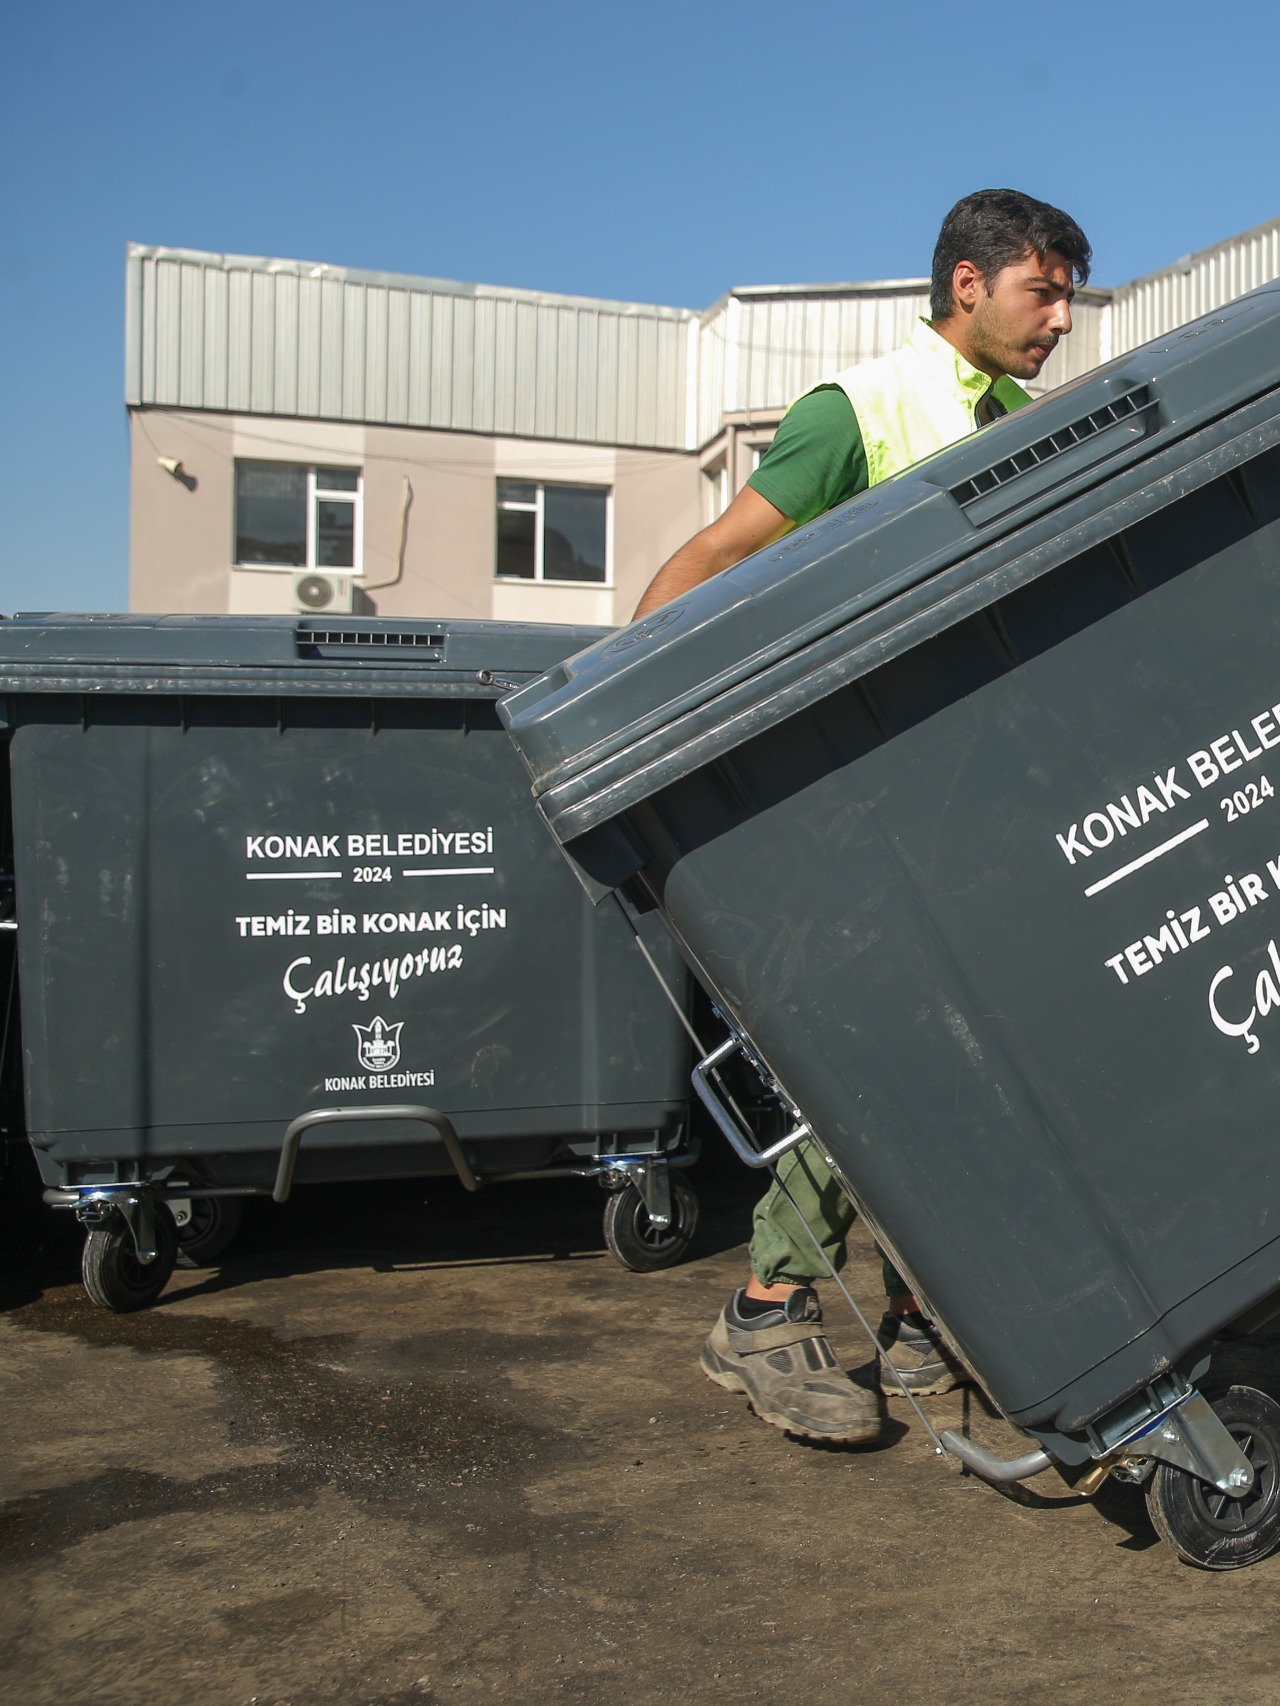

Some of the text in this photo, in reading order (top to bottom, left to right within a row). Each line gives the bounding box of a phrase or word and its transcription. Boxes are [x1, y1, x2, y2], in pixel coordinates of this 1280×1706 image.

[1056, 767, 1191, 864] KONAK
[1220, 776, 1275, 823] 2024
[247, 827, 493, 858] KONAK BELEDİYESİ
[353, 867, 392, 882] 2024
[236, 903, 507, 936] TEMİZ BİR KONAK İÇİN
[1104, 906, 1211, 984] TEMİZ
[1208, 874, 1270, 925] BİR
[283, 945, 463, 1014] Çalışıyoruz
[325, 1069, 434, 1091] KONAK BELEDİYESİ
